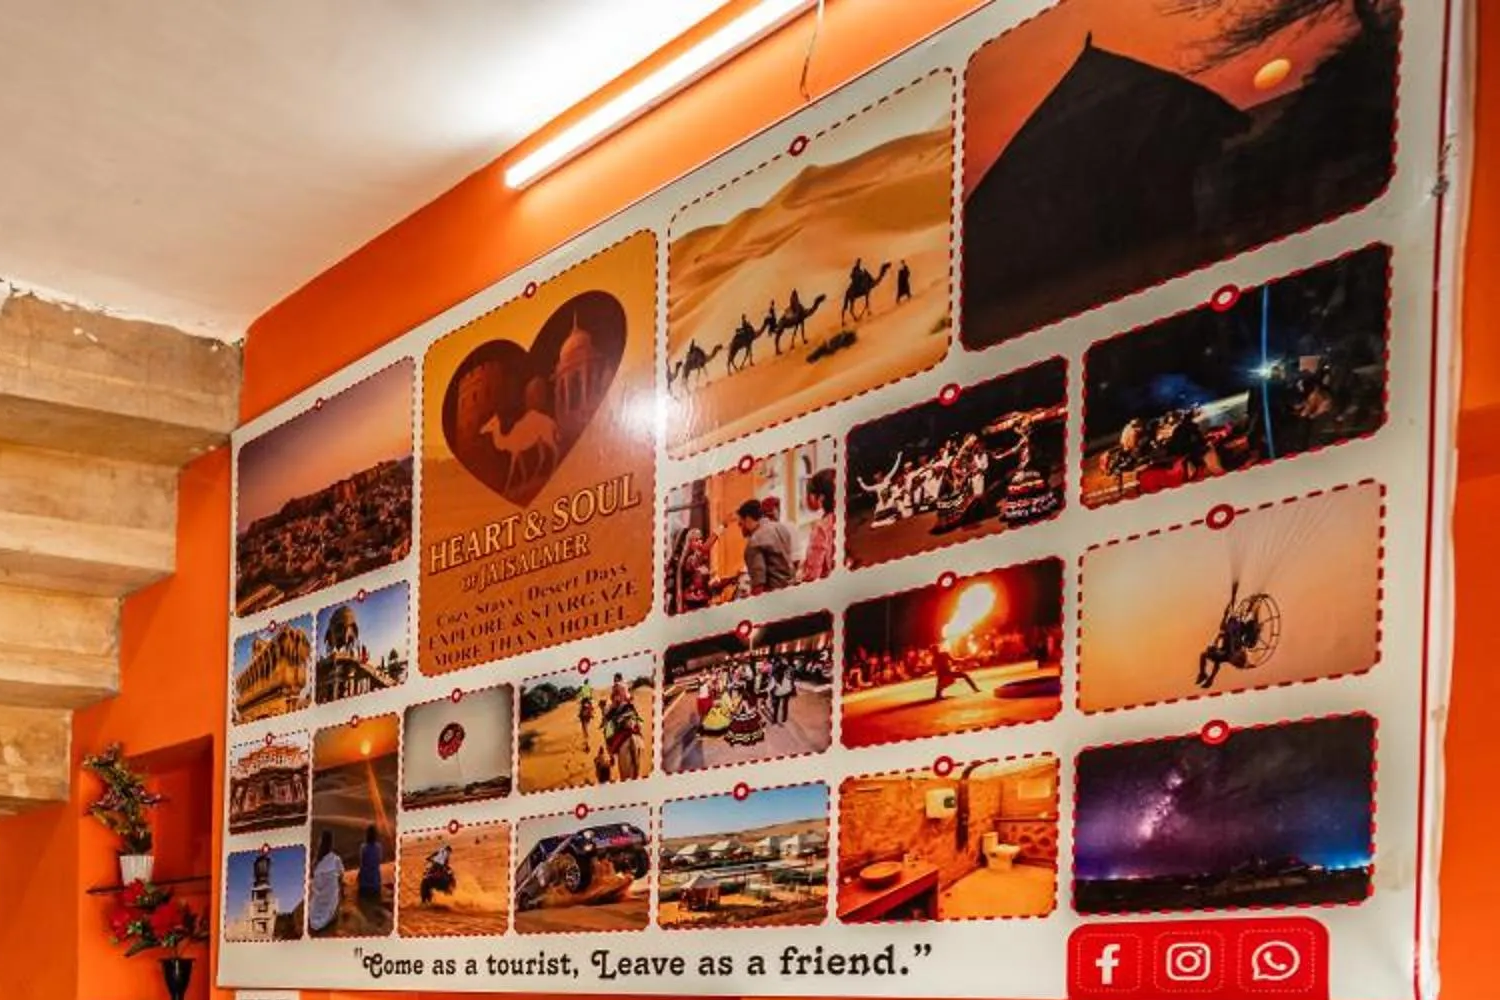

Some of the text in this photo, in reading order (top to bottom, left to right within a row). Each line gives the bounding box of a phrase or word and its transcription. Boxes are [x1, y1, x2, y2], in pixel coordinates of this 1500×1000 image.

[428, 472, 641, 575] HEART & SOUL
[478, 532, 591, 594] JAISALMER
[528, 575, 579, 600] Desert
[585, 564, 627, 587] Days
[428, 616, 504, 649] EXPLORE
[531, 580, 638, 621] STARGAZE
[435, 649, 483, 666] MORE
[491, 628, 537, 652] THAN
[560, 605, 629, 636] HOTEL
[432, 958, 456, 976] as
[465, 958, 478, 976] a
[486, 951, 579, 979] tourist,
[591, 950, 685, 979] Leave
[698, 954, 733, 976] as
[747, 954, 766, 976] a
